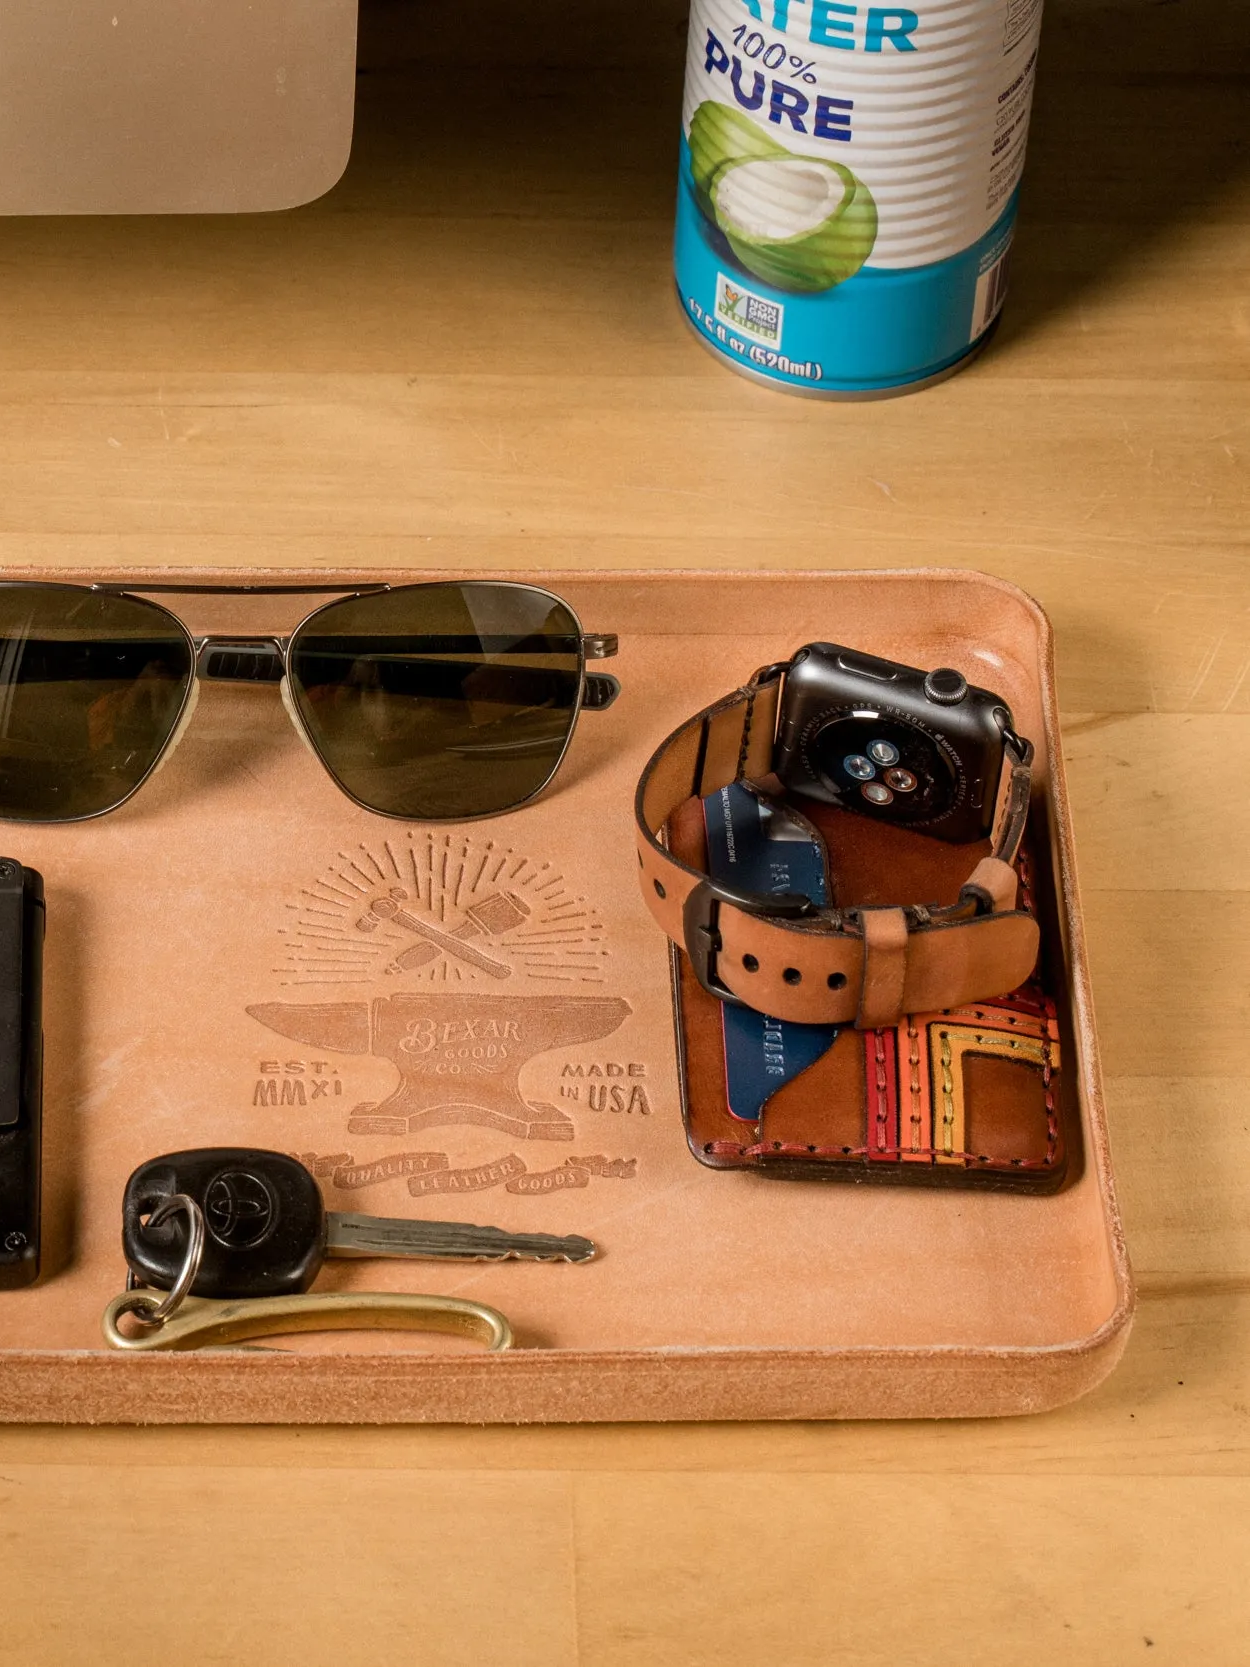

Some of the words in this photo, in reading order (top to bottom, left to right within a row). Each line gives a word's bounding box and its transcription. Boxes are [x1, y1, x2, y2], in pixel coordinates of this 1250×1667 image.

[740, 0, 919, 53] TER
[733, 24, 817, 84] 100%
[705, 28, 854, 142] PURE
[720, 303, 775, 338] VERIFIED
[748, 306, 777, 324] GMO
[748, 313, 777, 331] Project
[750, 299, 777, 316] NON
[940, 739, 963, 766] WATCH
[399, 1018, 523, 1054] BEXAR
[444, 1042, 508, 1060] GOODS
[259, 1060, 339, 1076] EST.
[560, 1063, 647, 1078] MADE
[253, 1078, 343, 1107] MMXI
[560, 1086, 579, 1101] IN
[587, 1085, 651, 1115] USA
[347, 1156, 431, 1185] QUALITY
[419, 1161, 516, 1191] LEATHER
[518, 1173, 577, 1190] GOODS
